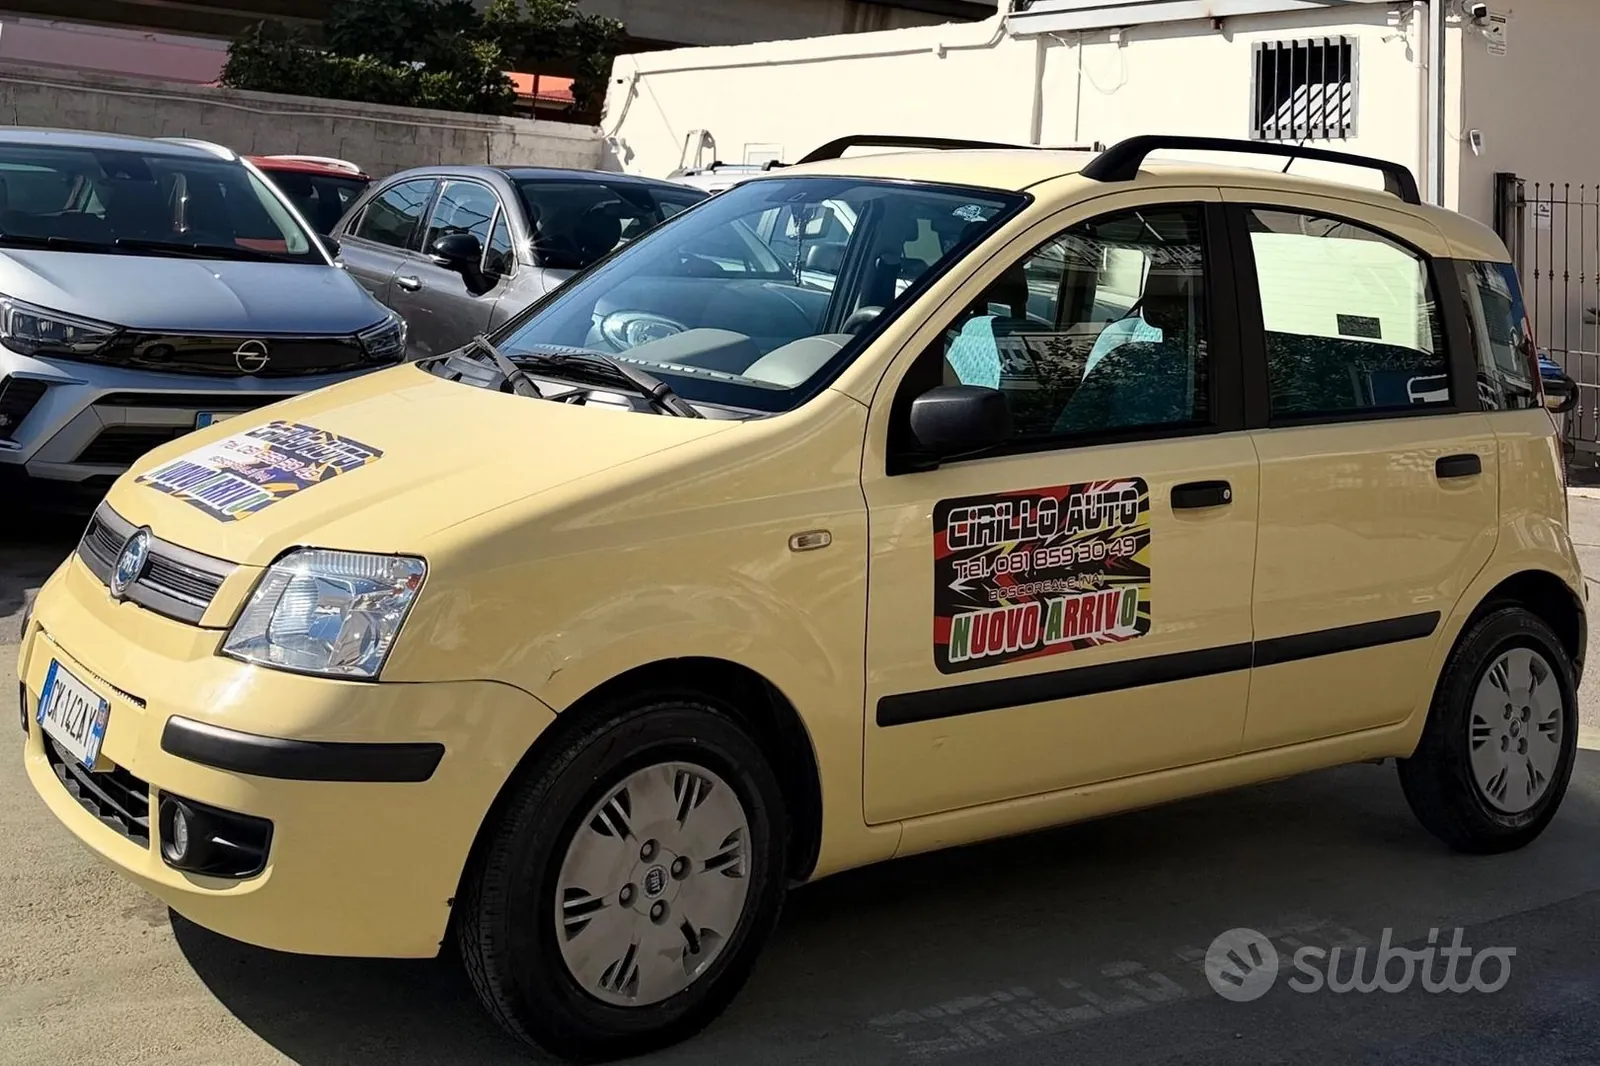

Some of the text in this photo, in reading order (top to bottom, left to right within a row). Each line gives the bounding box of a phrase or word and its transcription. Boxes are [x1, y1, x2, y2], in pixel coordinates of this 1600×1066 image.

[1064, 487, 1139, 535] AUTO
[953, 535, 1137, 580] Tel. 081 859 30 49
[989, 569, 1105, 601] BOSCOREALE (NA)
[948, 587, 1139, 662] NUOVO ARRIVO
